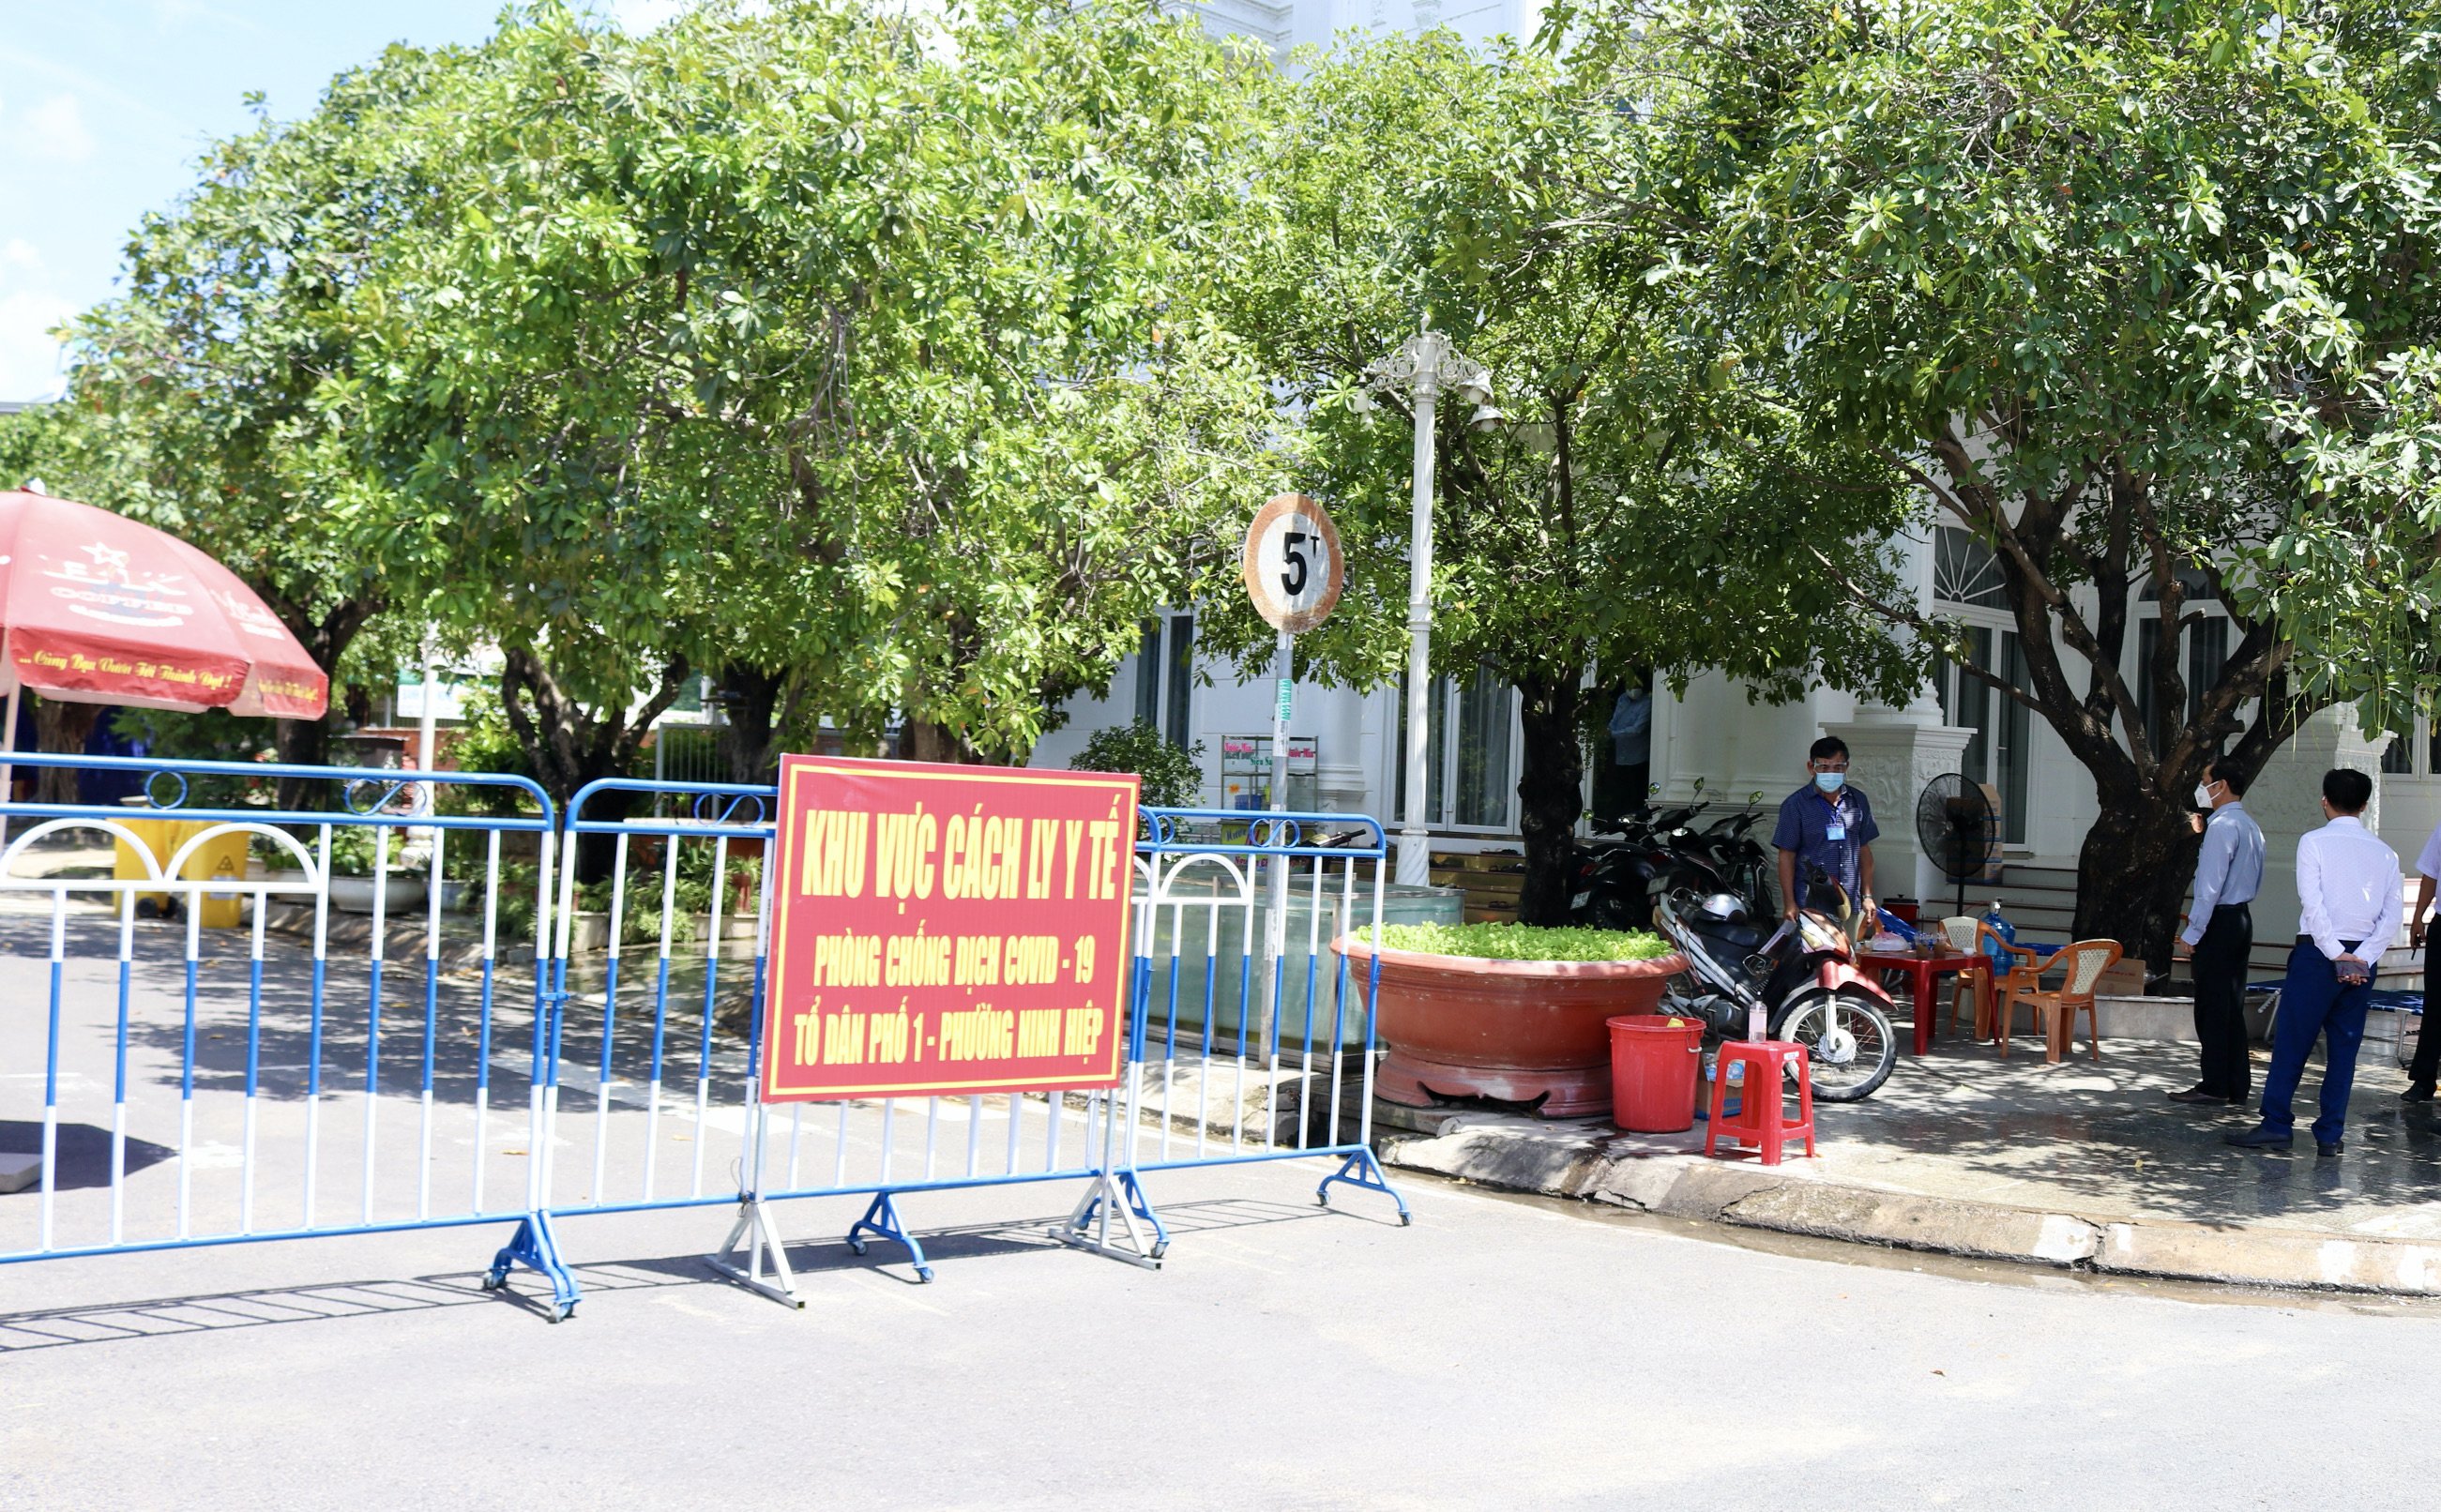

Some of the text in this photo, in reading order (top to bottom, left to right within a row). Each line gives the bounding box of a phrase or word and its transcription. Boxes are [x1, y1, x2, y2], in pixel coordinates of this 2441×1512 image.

[1281, 532, 1308, 596] 5
[800, 794, 1122, 915] KHU VỰC CÁCH LY Y TẾ
[812, 927, 880, 988] PHÒNG
[885, 918, 950, 988] CHỐNG
[953, 934, 1001, 995] DỊCH
[1004, 934, 1060, 986] COVID
[1074, 934, 1096, 984] 19
[794, 995, 819, 1066] TỔ
[823, 1005, 866, 1066] DÂN
[868, 995, 909, 1065] PHỐ
[912, 1012, 924, 1063] 1
[938, 1002, 1014, 1062] PHƯỜNG
[1016, 1008, 1059, 1059] NINH
[1064, 1000, 1104, 1065] HIỆP
